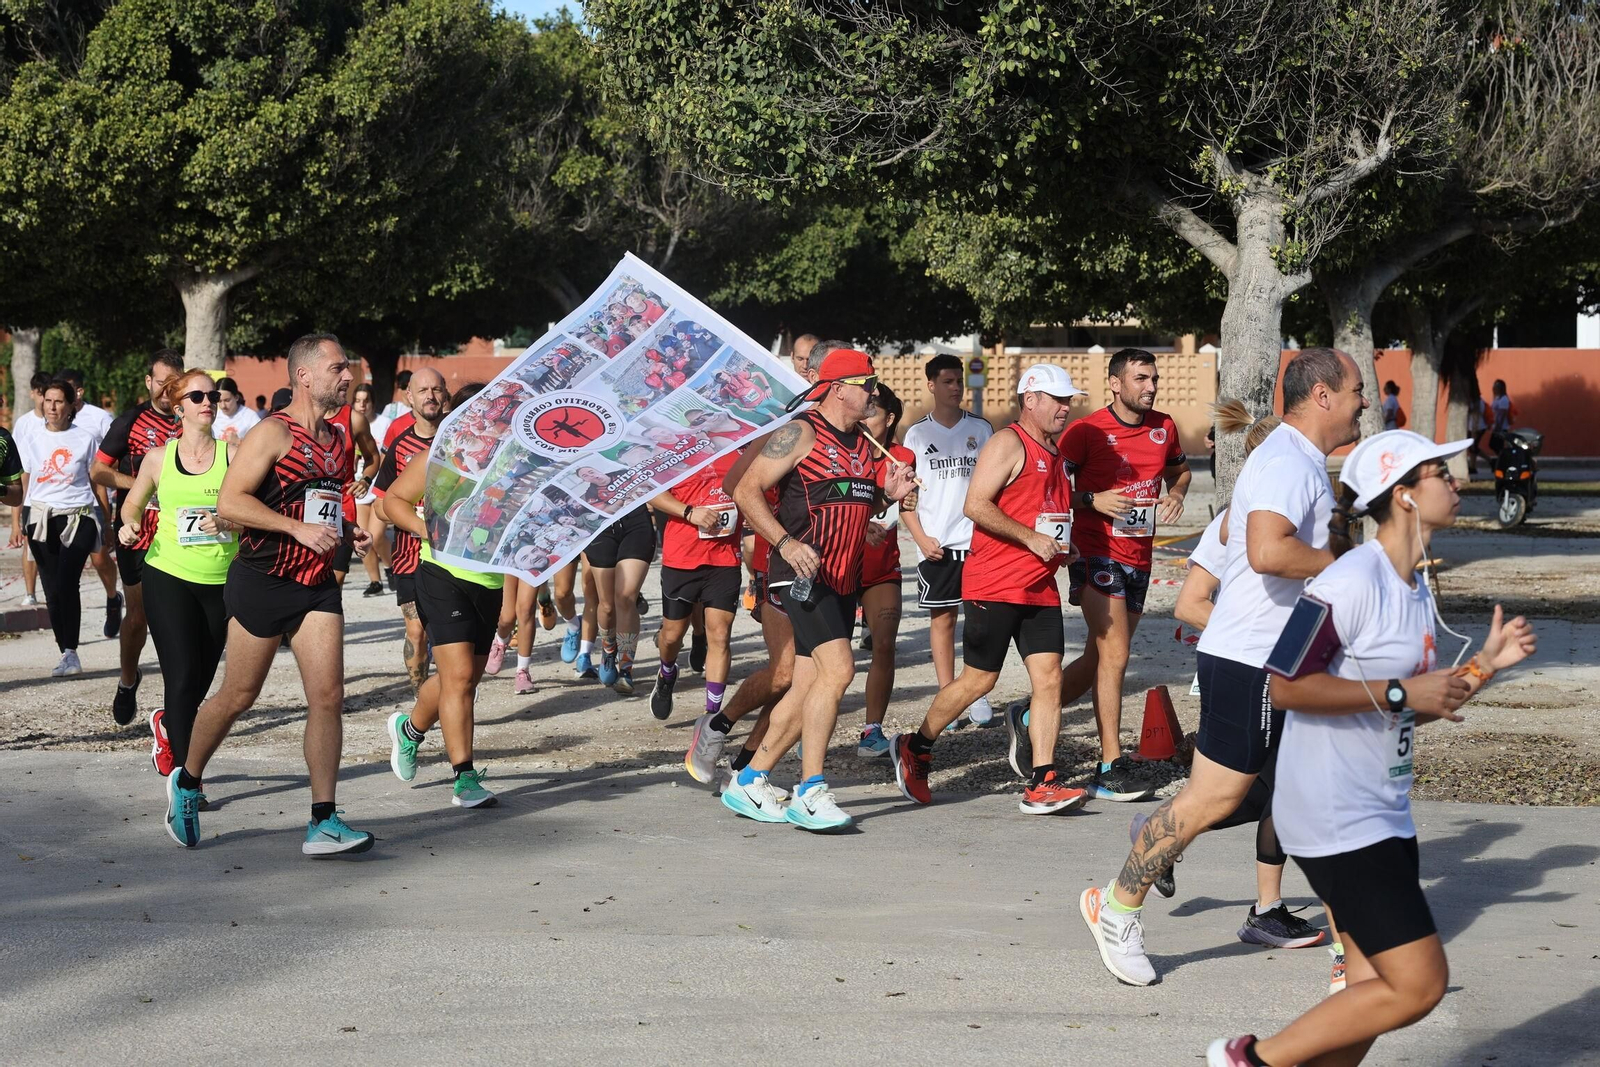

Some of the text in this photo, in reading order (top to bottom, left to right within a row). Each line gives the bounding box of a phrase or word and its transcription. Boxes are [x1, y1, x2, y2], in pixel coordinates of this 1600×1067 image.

[929, 455, 977, 470] Emirates
[938, 468, 971, 480] FLY BETTER
[318, 502, 338, 521] 44
[1126, 508, 1147, 526] 34
[1054, 524, 1064, 540] 2
[1145, 727, 1165, 739] DPT
